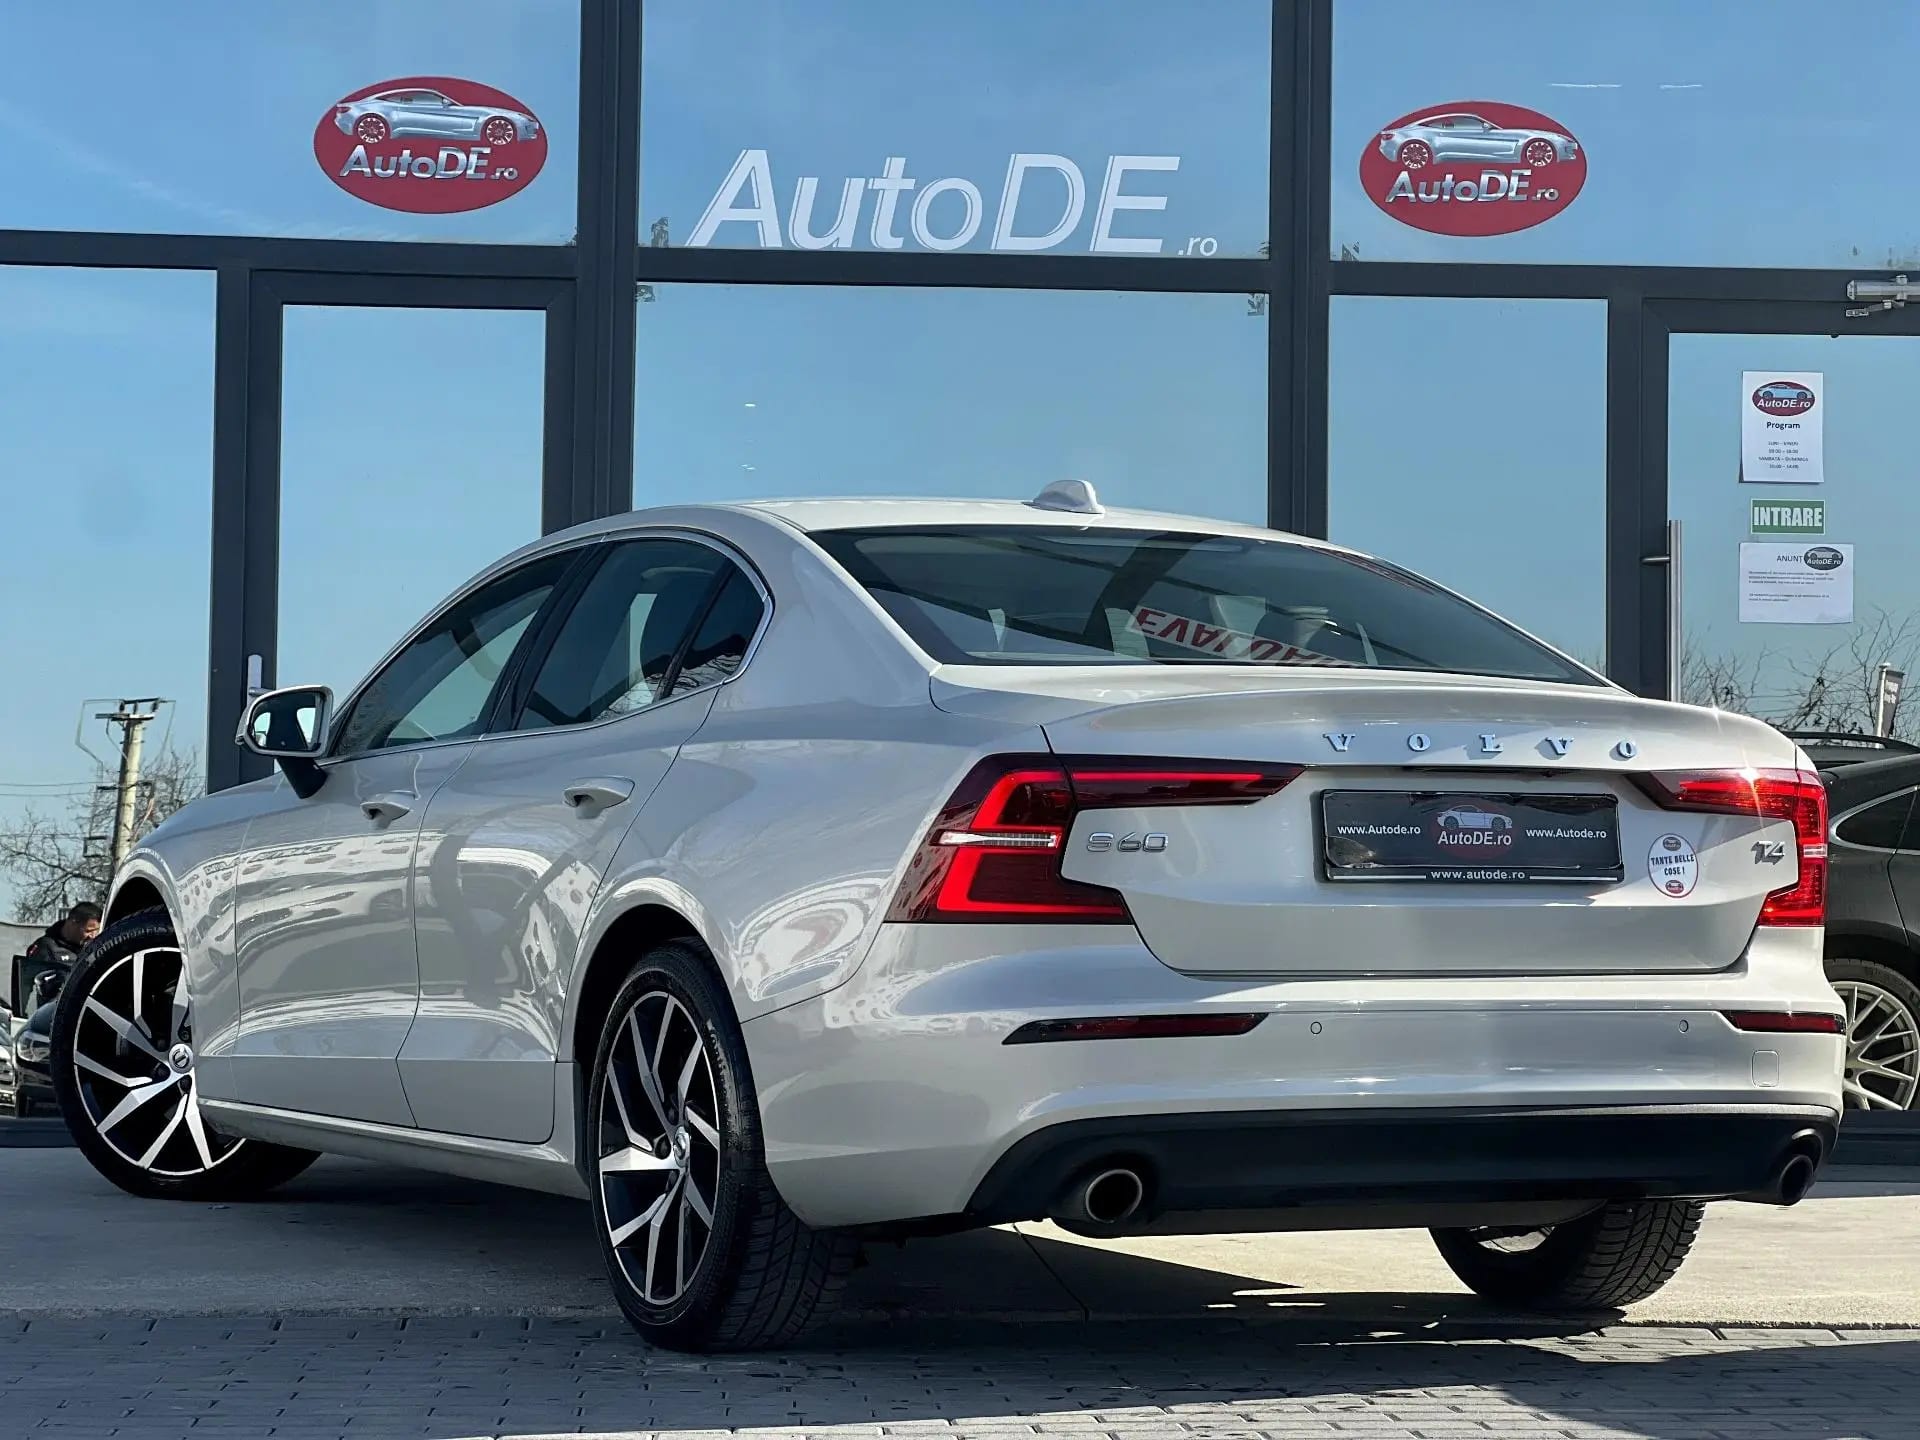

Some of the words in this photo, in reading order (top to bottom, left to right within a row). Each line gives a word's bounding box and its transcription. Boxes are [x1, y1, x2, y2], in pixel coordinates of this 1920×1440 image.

[1757, 398, 1811, 408] AutoDE.ro
[1766, 421, 1801, 430] Program
[1753, 506, 1823, 526] INTRARE
[1322, 732, 1638, 758] VOLVO
[1337, 824, 1421, 835] www.Autode.ro
[1525, 828, 1607, 839] www.Autode.ro
[1087, 832, 1169, 852] S60
[1437, 831, 1512, 846] AutoDE.ro
[1751, 840, 1786, 865] T4
[1650, 855, 1673, 866] TANTE
[1674, 854, 1695, 863] BELLE
[1430, 870, 1526, 880] www.autode.ro
[1663, 866, 1681, 876] COSE
